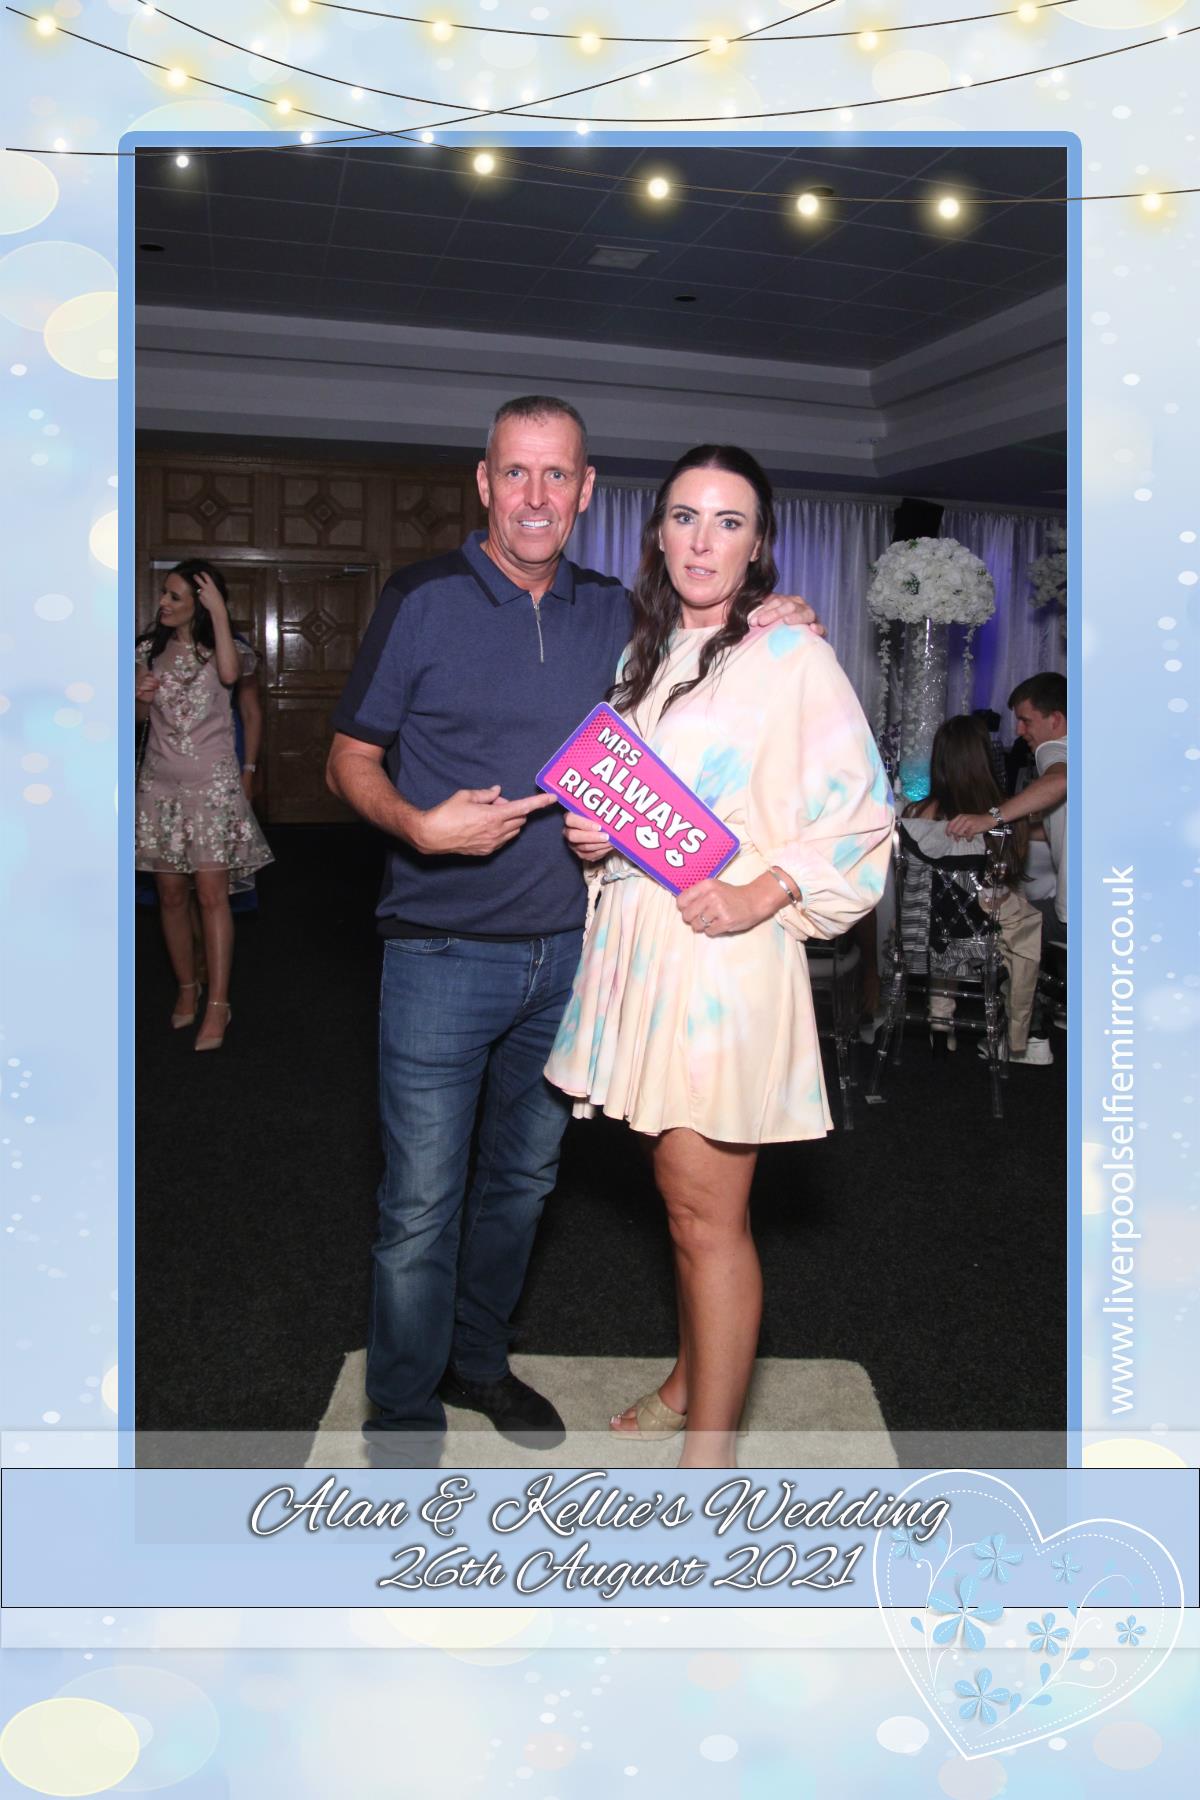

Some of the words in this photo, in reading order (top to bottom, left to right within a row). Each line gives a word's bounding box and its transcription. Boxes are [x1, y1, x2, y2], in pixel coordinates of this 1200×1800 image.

[597, 727, 643, 767] MRS
[557, 767, 635, 832] RIGHT
[590, 755, 708, 854] ALWAYS
